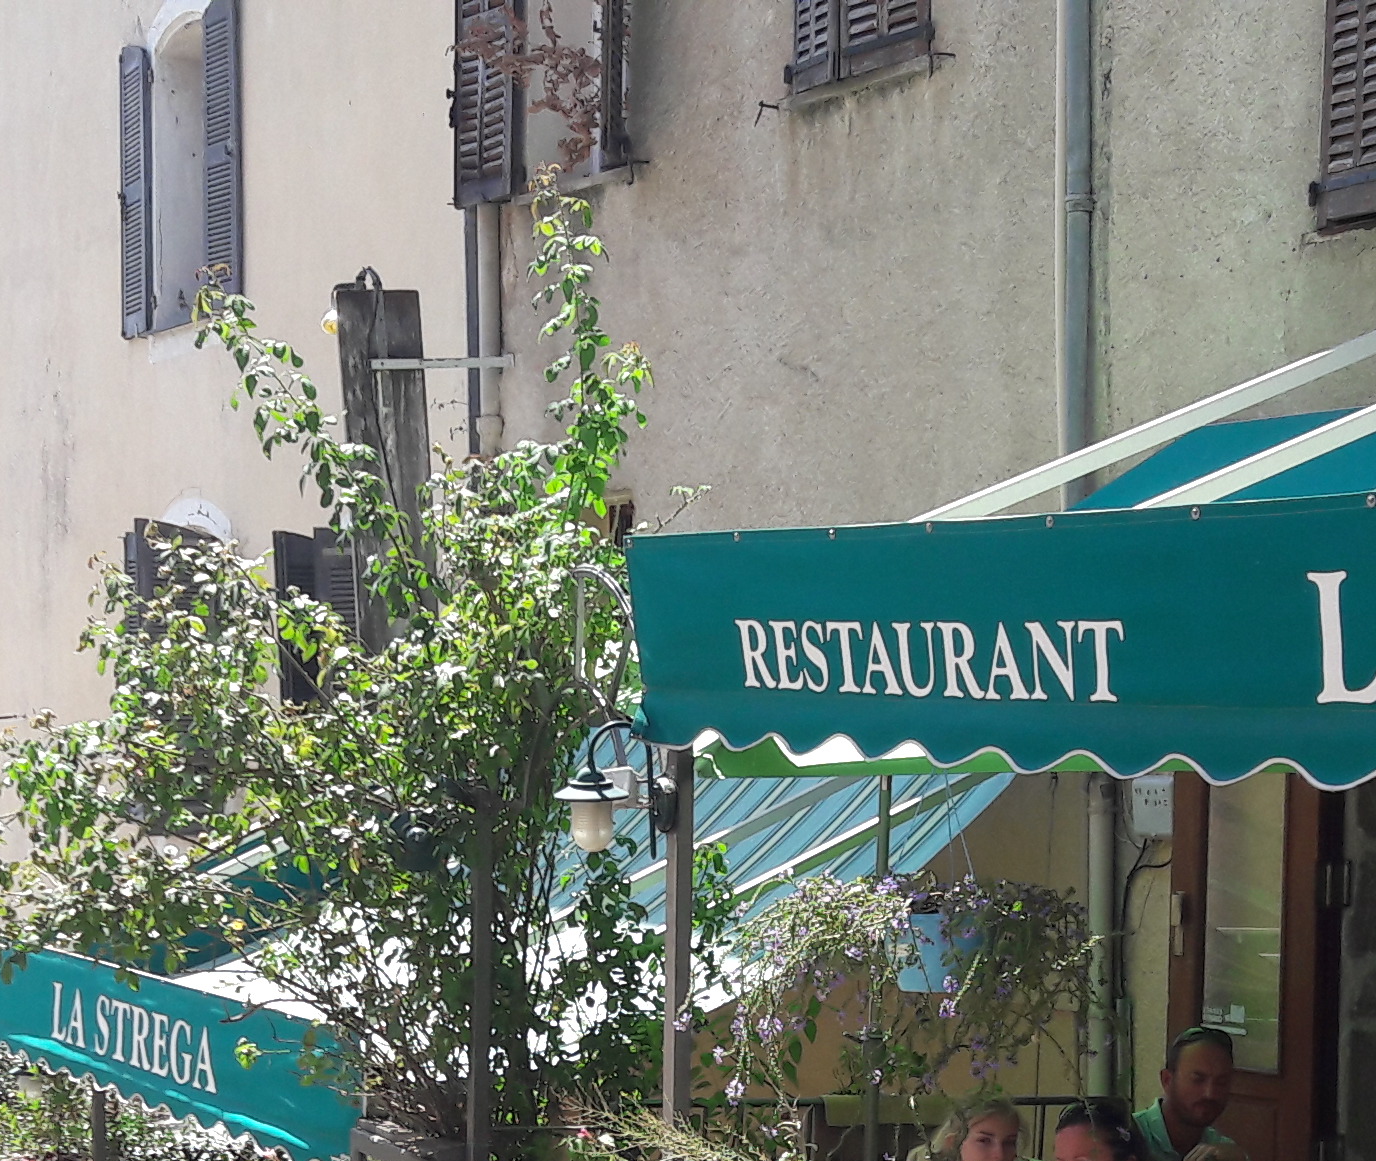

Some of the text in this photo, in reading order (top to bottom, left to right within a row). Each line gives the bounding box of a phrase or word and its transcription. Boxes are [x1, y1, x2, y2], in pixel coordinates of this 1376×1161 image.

[734, 618, 1124, 703] RESTAURANT
[50, 980, 218, 1095] LA STREGA
